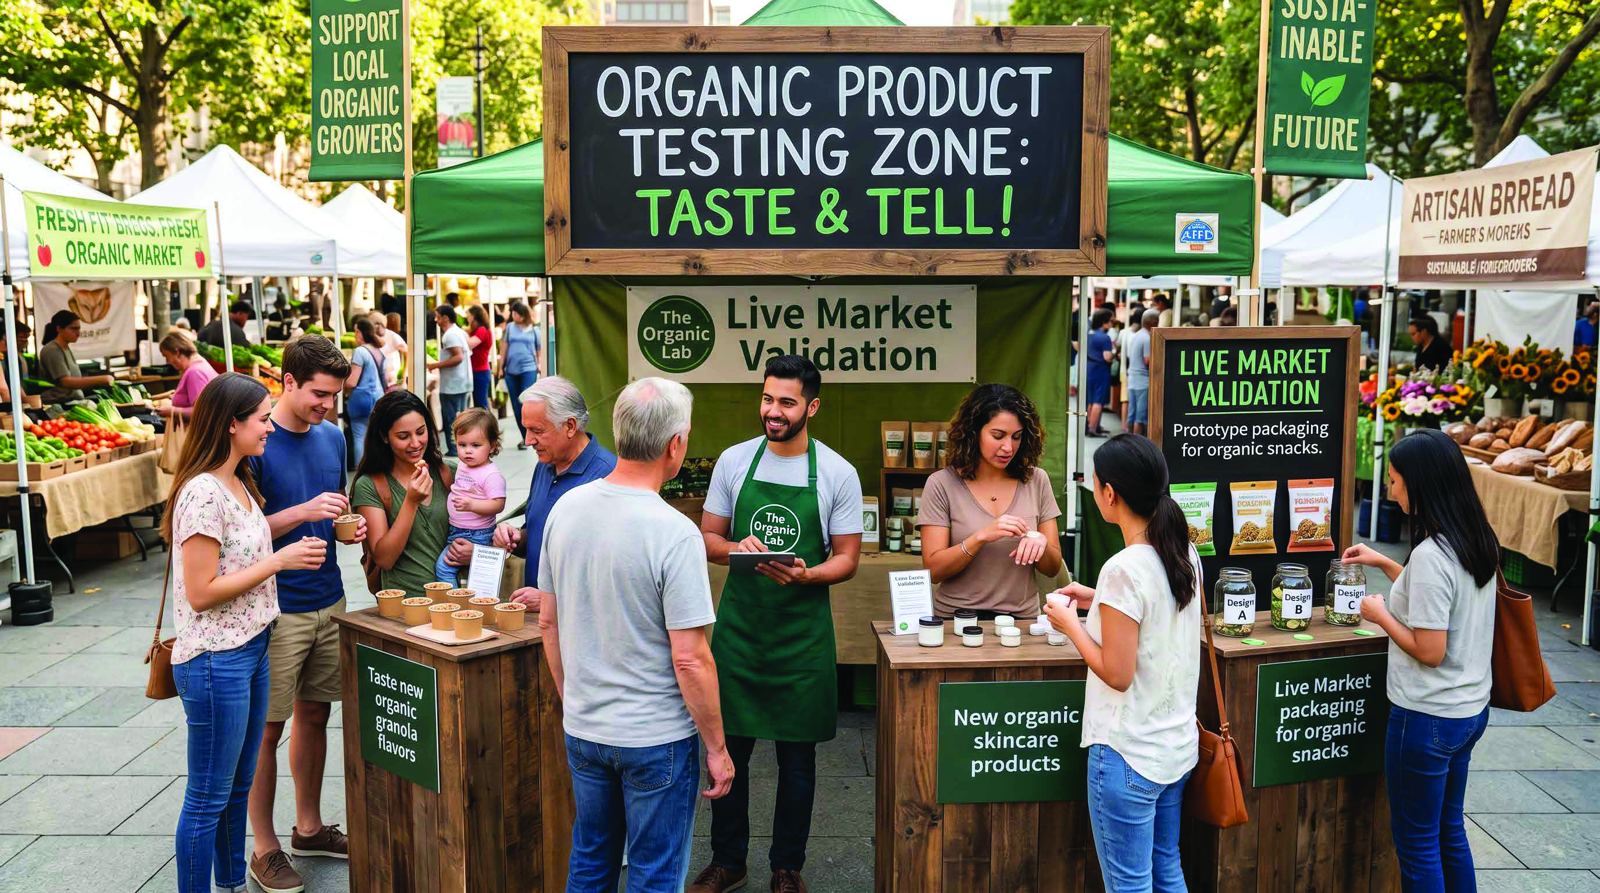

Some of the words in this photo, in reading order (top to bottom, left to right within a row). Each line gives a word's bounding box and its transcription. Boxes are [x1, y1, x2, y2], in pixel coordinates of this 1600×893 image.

[319, 9, 400, 45] SUPPORT
[1280, 25, 1365, 64] INABLE
[333, 49, 389, 82] LOCAL
[320, 85, 399, 119] ORGANIC
[597, 65, 812, 118] ORGANIC
[838, 66, 1052, 118] PRODUCT
[317, 122, 403, 155] GROWERS
[1273, 114, 1359, 152] FUTURE
[619, 127, 849, 177] TESTING
[871, 127, 1030, 177] ZONE:
[1411, 185, 1485, 223] ARTISAN
[1490, 171, 1576, 216] BRREAD
[36, 205, 87, 232] FRESH
[160, 217, 201, 239] FRESH
[636, 188, 796, 237] TASTE
[815, 187, 850, 235] &
[867, 185, 1014, 237] TELL!
[66, 240, 130, 266] ORGANIC
[133, 245, 183, 266] MARKET
[661, 310, 692, 325] The
[728, 295, 804, 329] Live
[818, 295, 952, 329] Market
[643, 326, 710, 344] Organic
[662, 345, 692, 359] Lab
[1180, 350, 1229, 376] LIVE
[1238, 348, 1331, 375] MARKET
[1188, 379, 1320, 407] VALIDATION
[1173, 422, 1248, 440] Prototype
[1252, 420, 1329, 438] packaging
[1182, 442, 1204, 458] for
[1207, 442, 1263, 459] organic
[1267, 440, 1322, 456] snacks.
[754, 521, 796, 536] Organic
[766, 512, 785, 524] The
[764, 535, 784, 546] Lab
[1227, 599, 1255, 608] Design
[1285, 593, 1311, 603] Design
[1338, 589, 1364, 598] Design
[1348, 601, 1355, 610] C
[1238, 611, 1247, 620] A
[1295, 605, 1303, 614] B
[368, 666, 397, 691] Taste
[400, 681, 423, 700] new
[1275, 680, 1309, 697] Live
[1314, 674, 1371, 693] Market
[375, 694, 417, 720] organic
[954, 709, 998, 726] New
[1004, 706, 1079, 729] organic
[1280, 697, 1365, 724] packaging
[376, 715, 417, 742] granola
[973, 731, 1059, 749] skincare
[1276, 726, 1301, 742] for
[1304, 718, 1366, 741] organic
[378, 734, 416, 763] flavors
[1292, 742, 1349, 763] snacks
[971, 754, 1061, 777] products
